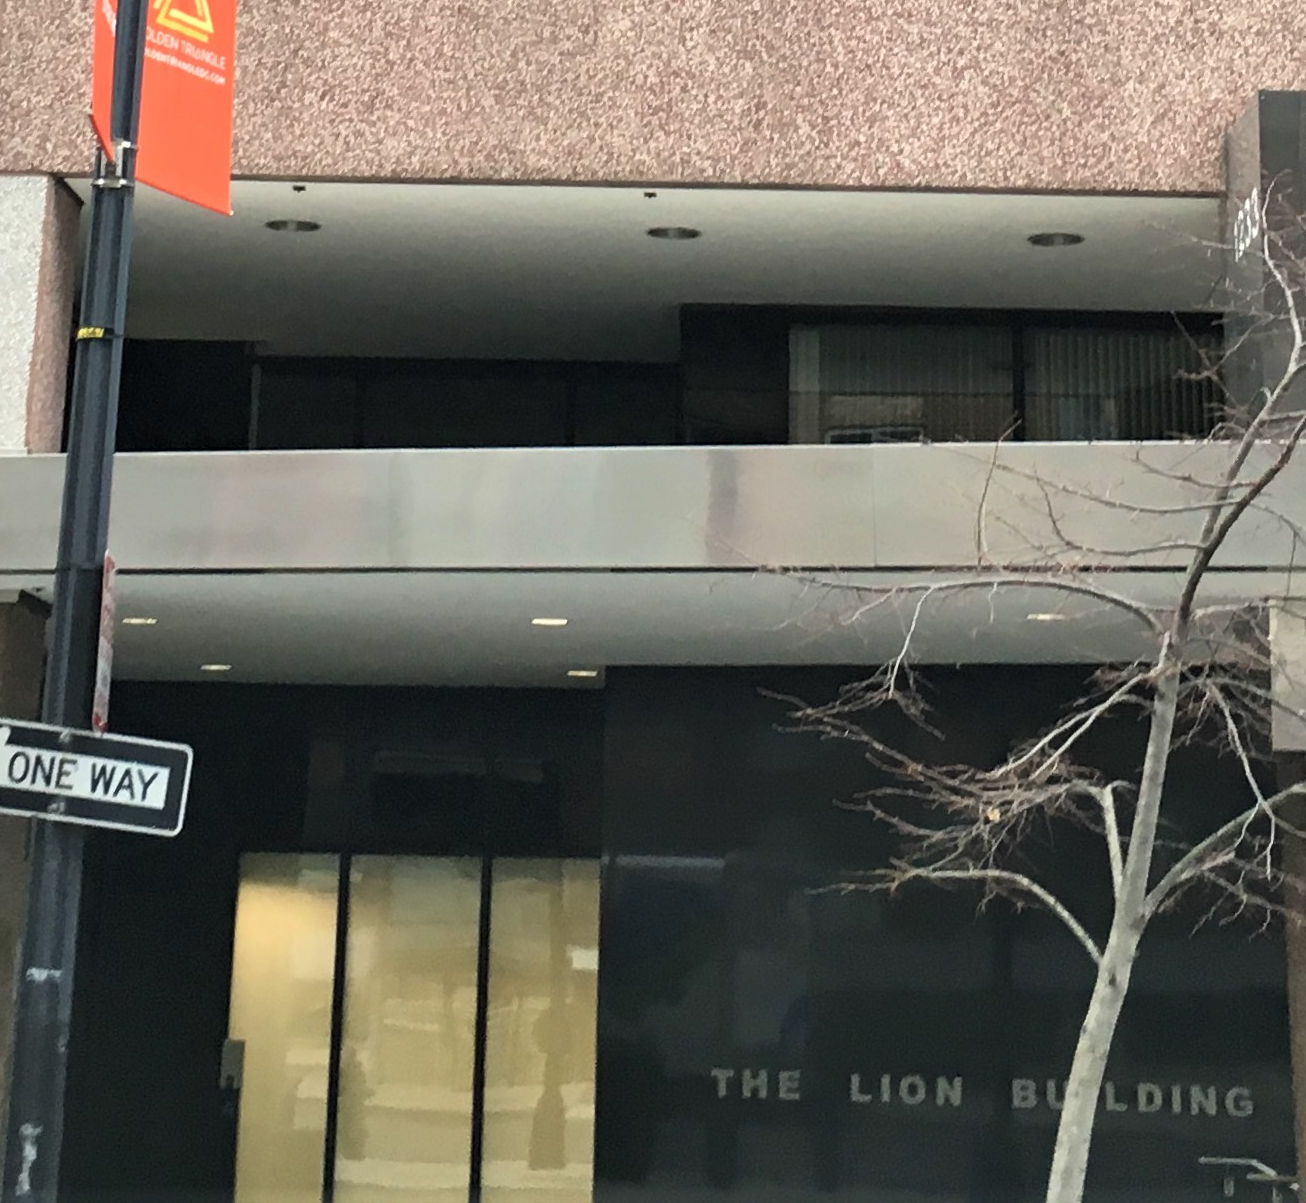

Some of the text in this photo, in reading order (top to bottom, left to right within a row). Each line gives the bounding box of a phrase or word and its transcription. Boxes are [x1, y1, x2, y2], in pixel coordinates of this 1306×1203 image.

[145, 25, 180, 51] OLDEN
[8, 751, 159, 802] ONE WAY
[711, 1068, 1255, 1118] THE LION BULDING
